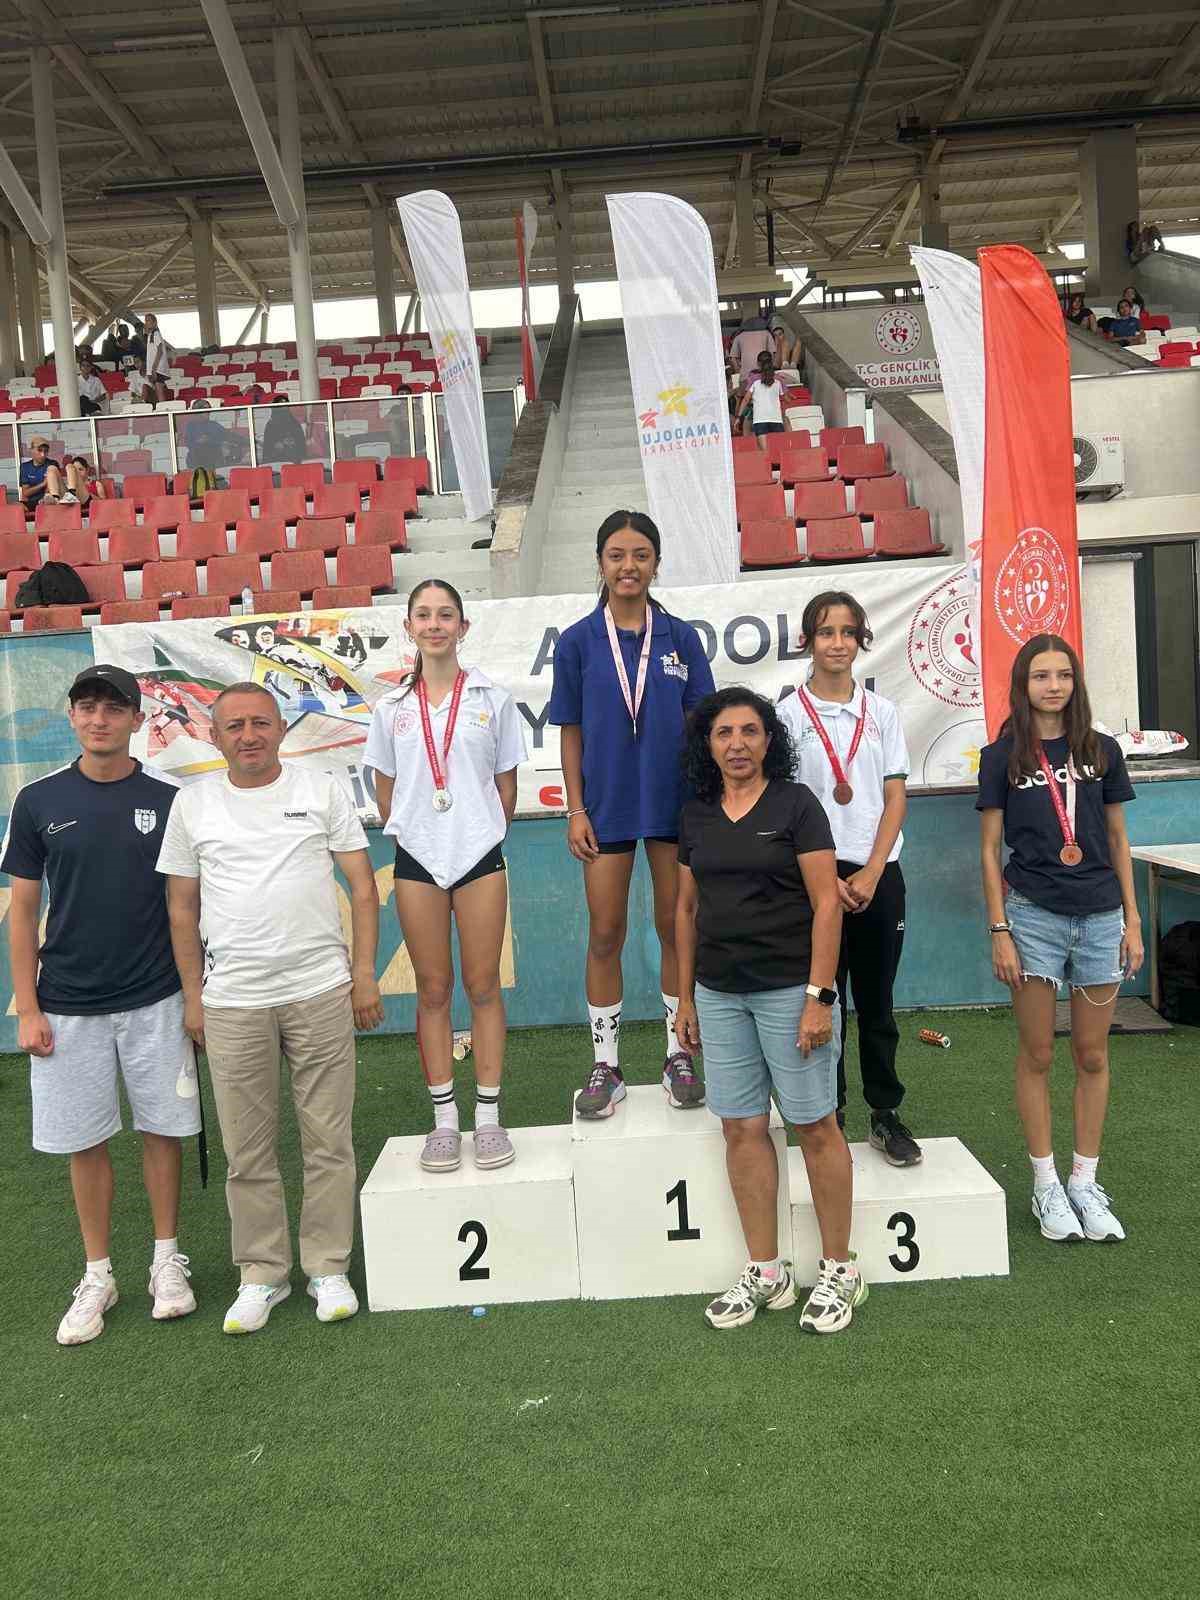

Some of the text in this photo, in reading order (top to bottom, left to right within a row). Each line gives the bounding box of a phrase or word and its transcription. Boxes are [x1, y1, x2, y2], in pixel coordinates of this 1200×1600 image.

[857, 364, 877, 375] T.C.
[880, 360, 930, 374] GENÇLİK
[864, 376, 887, 387] POR
[666, 1179, 701, 1241] 1
[457, 1220, 490, 1281] 2
[887, 1211, 920, 1272] 3
